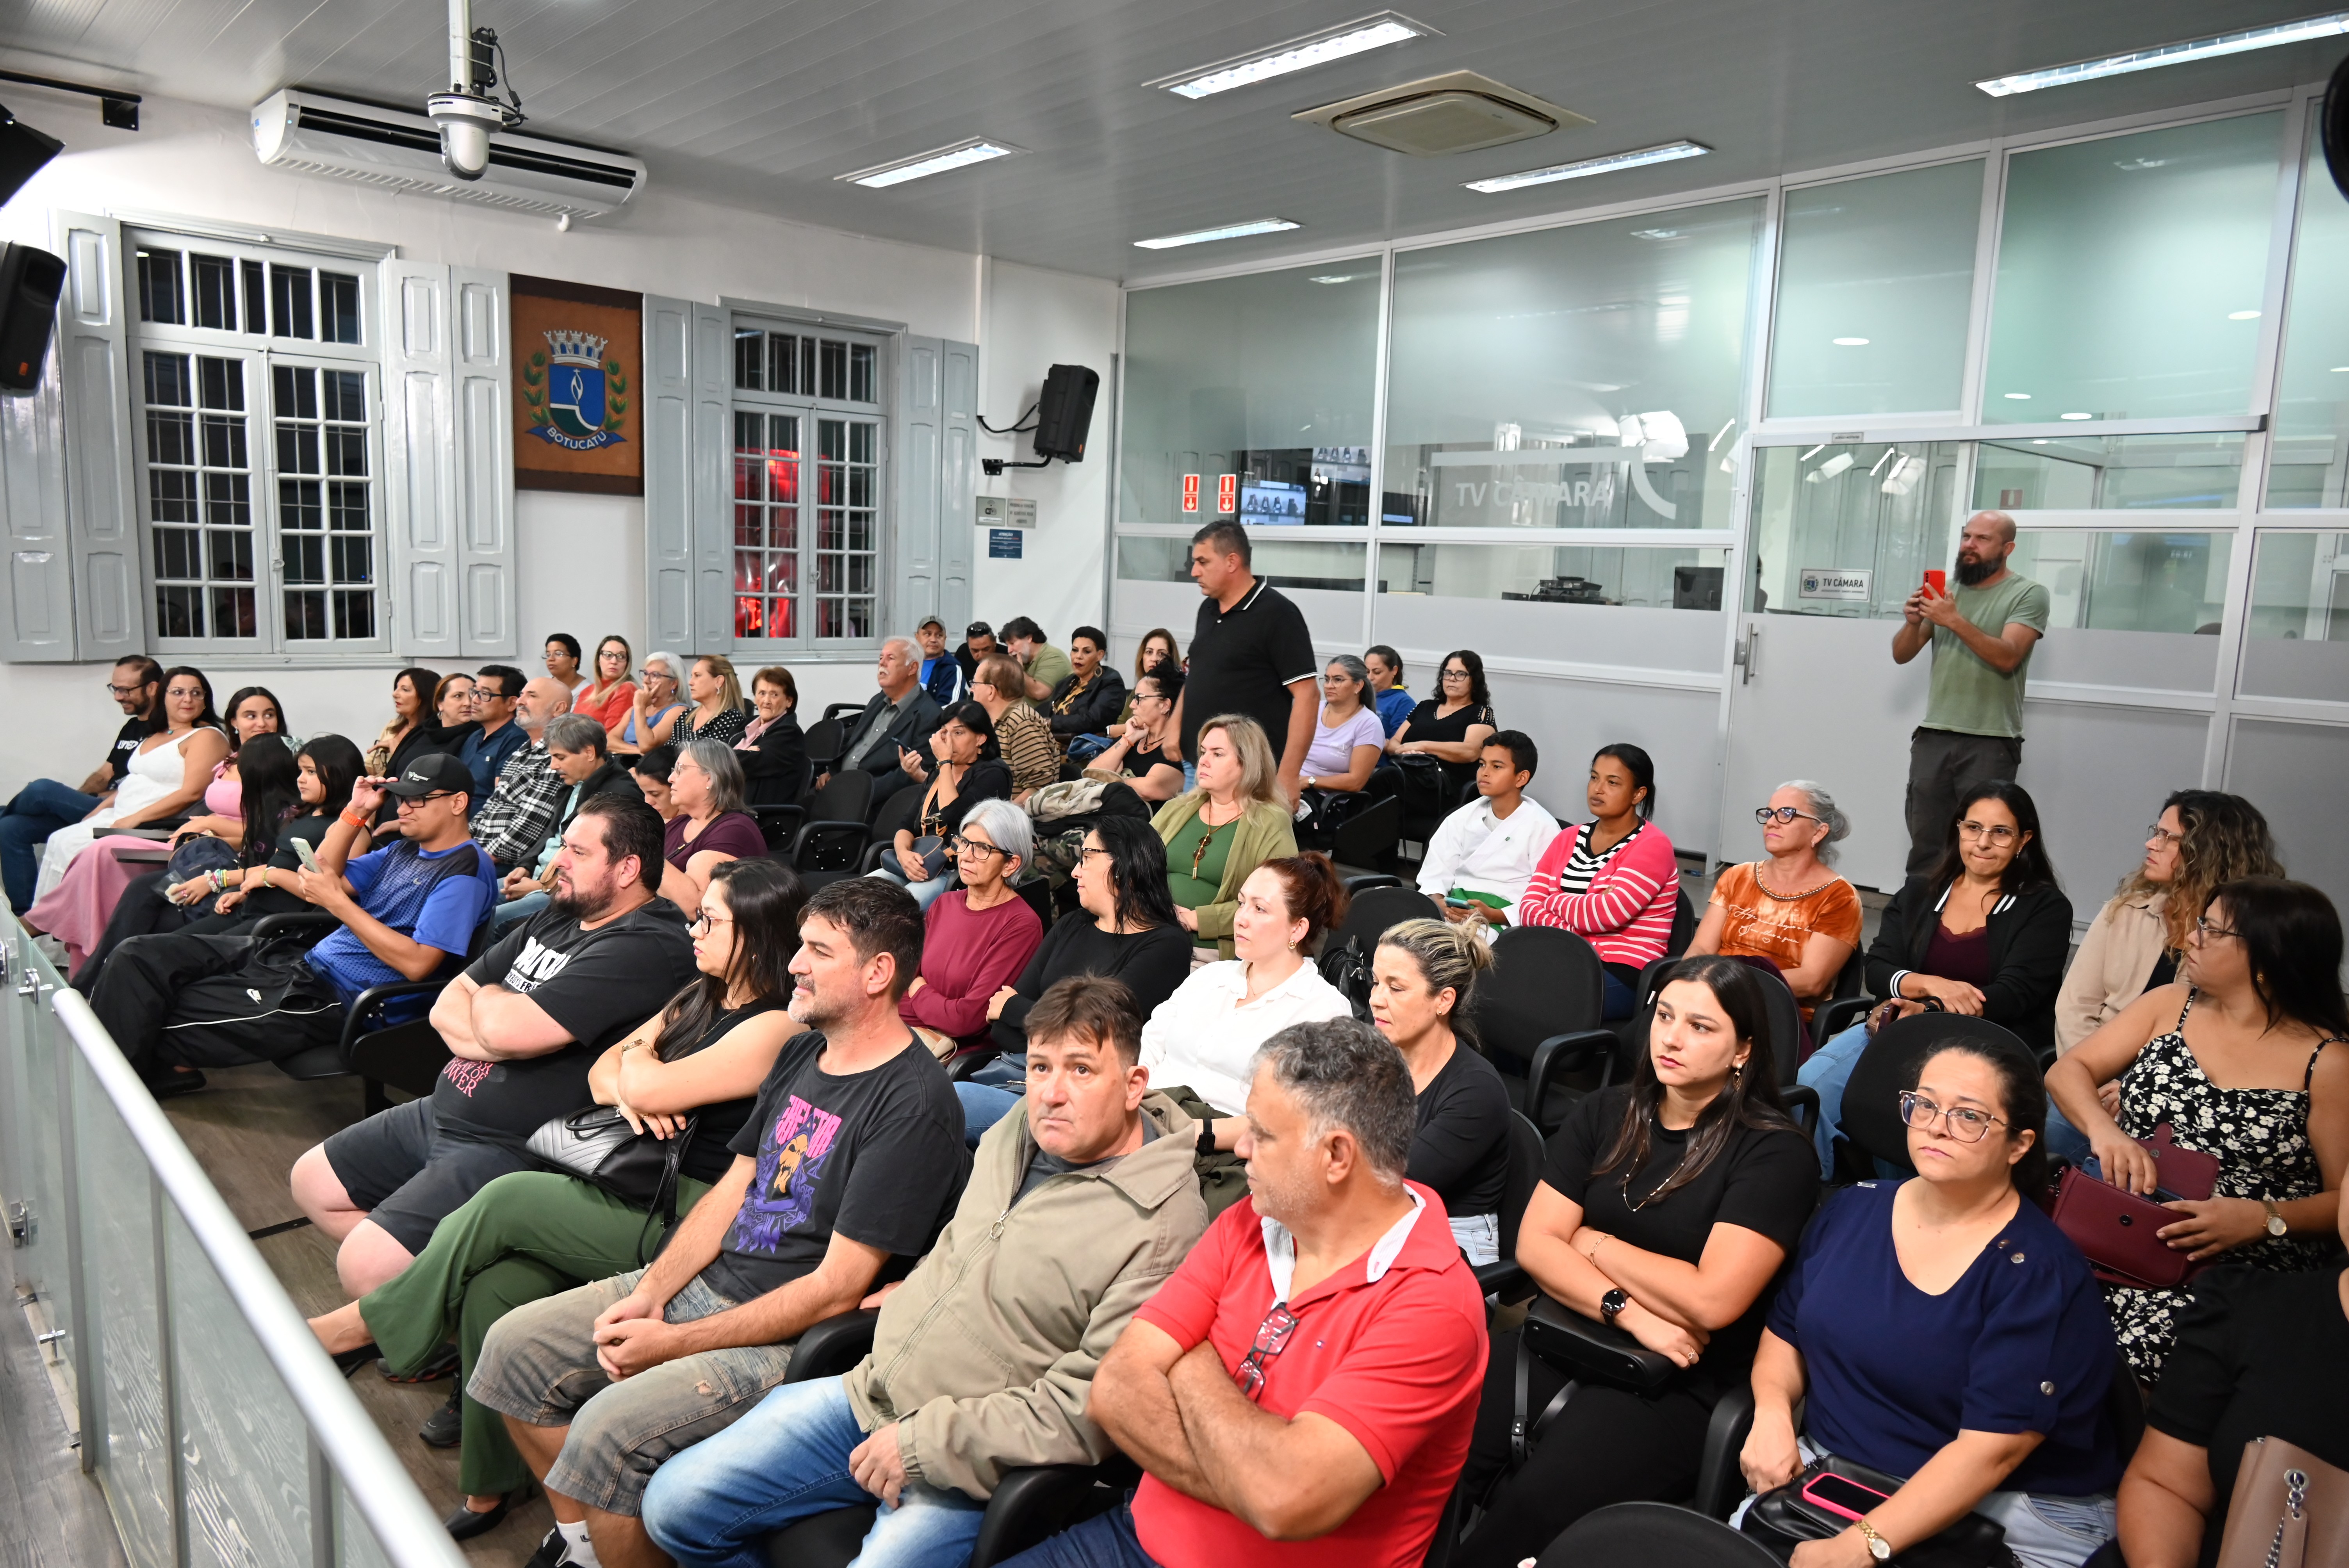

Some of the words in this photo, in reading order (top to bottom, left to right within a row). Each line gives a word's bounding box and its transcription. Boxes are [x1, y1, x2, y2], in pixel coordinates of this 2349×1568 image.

[547, 427, 607, 449] BOTUCATU
[1456, 483, 1487, 507] TV
[1493, 476, 1609, 507] CÂMARA
[1823, 578, 1832, 586] TV
[1834, 577, 1864, 588] CÂMARA
[507, 972, 522, 987] BOYS
[444, 1060, 477, 1098] OWER
[470, 1069, 487, 1082] OF
